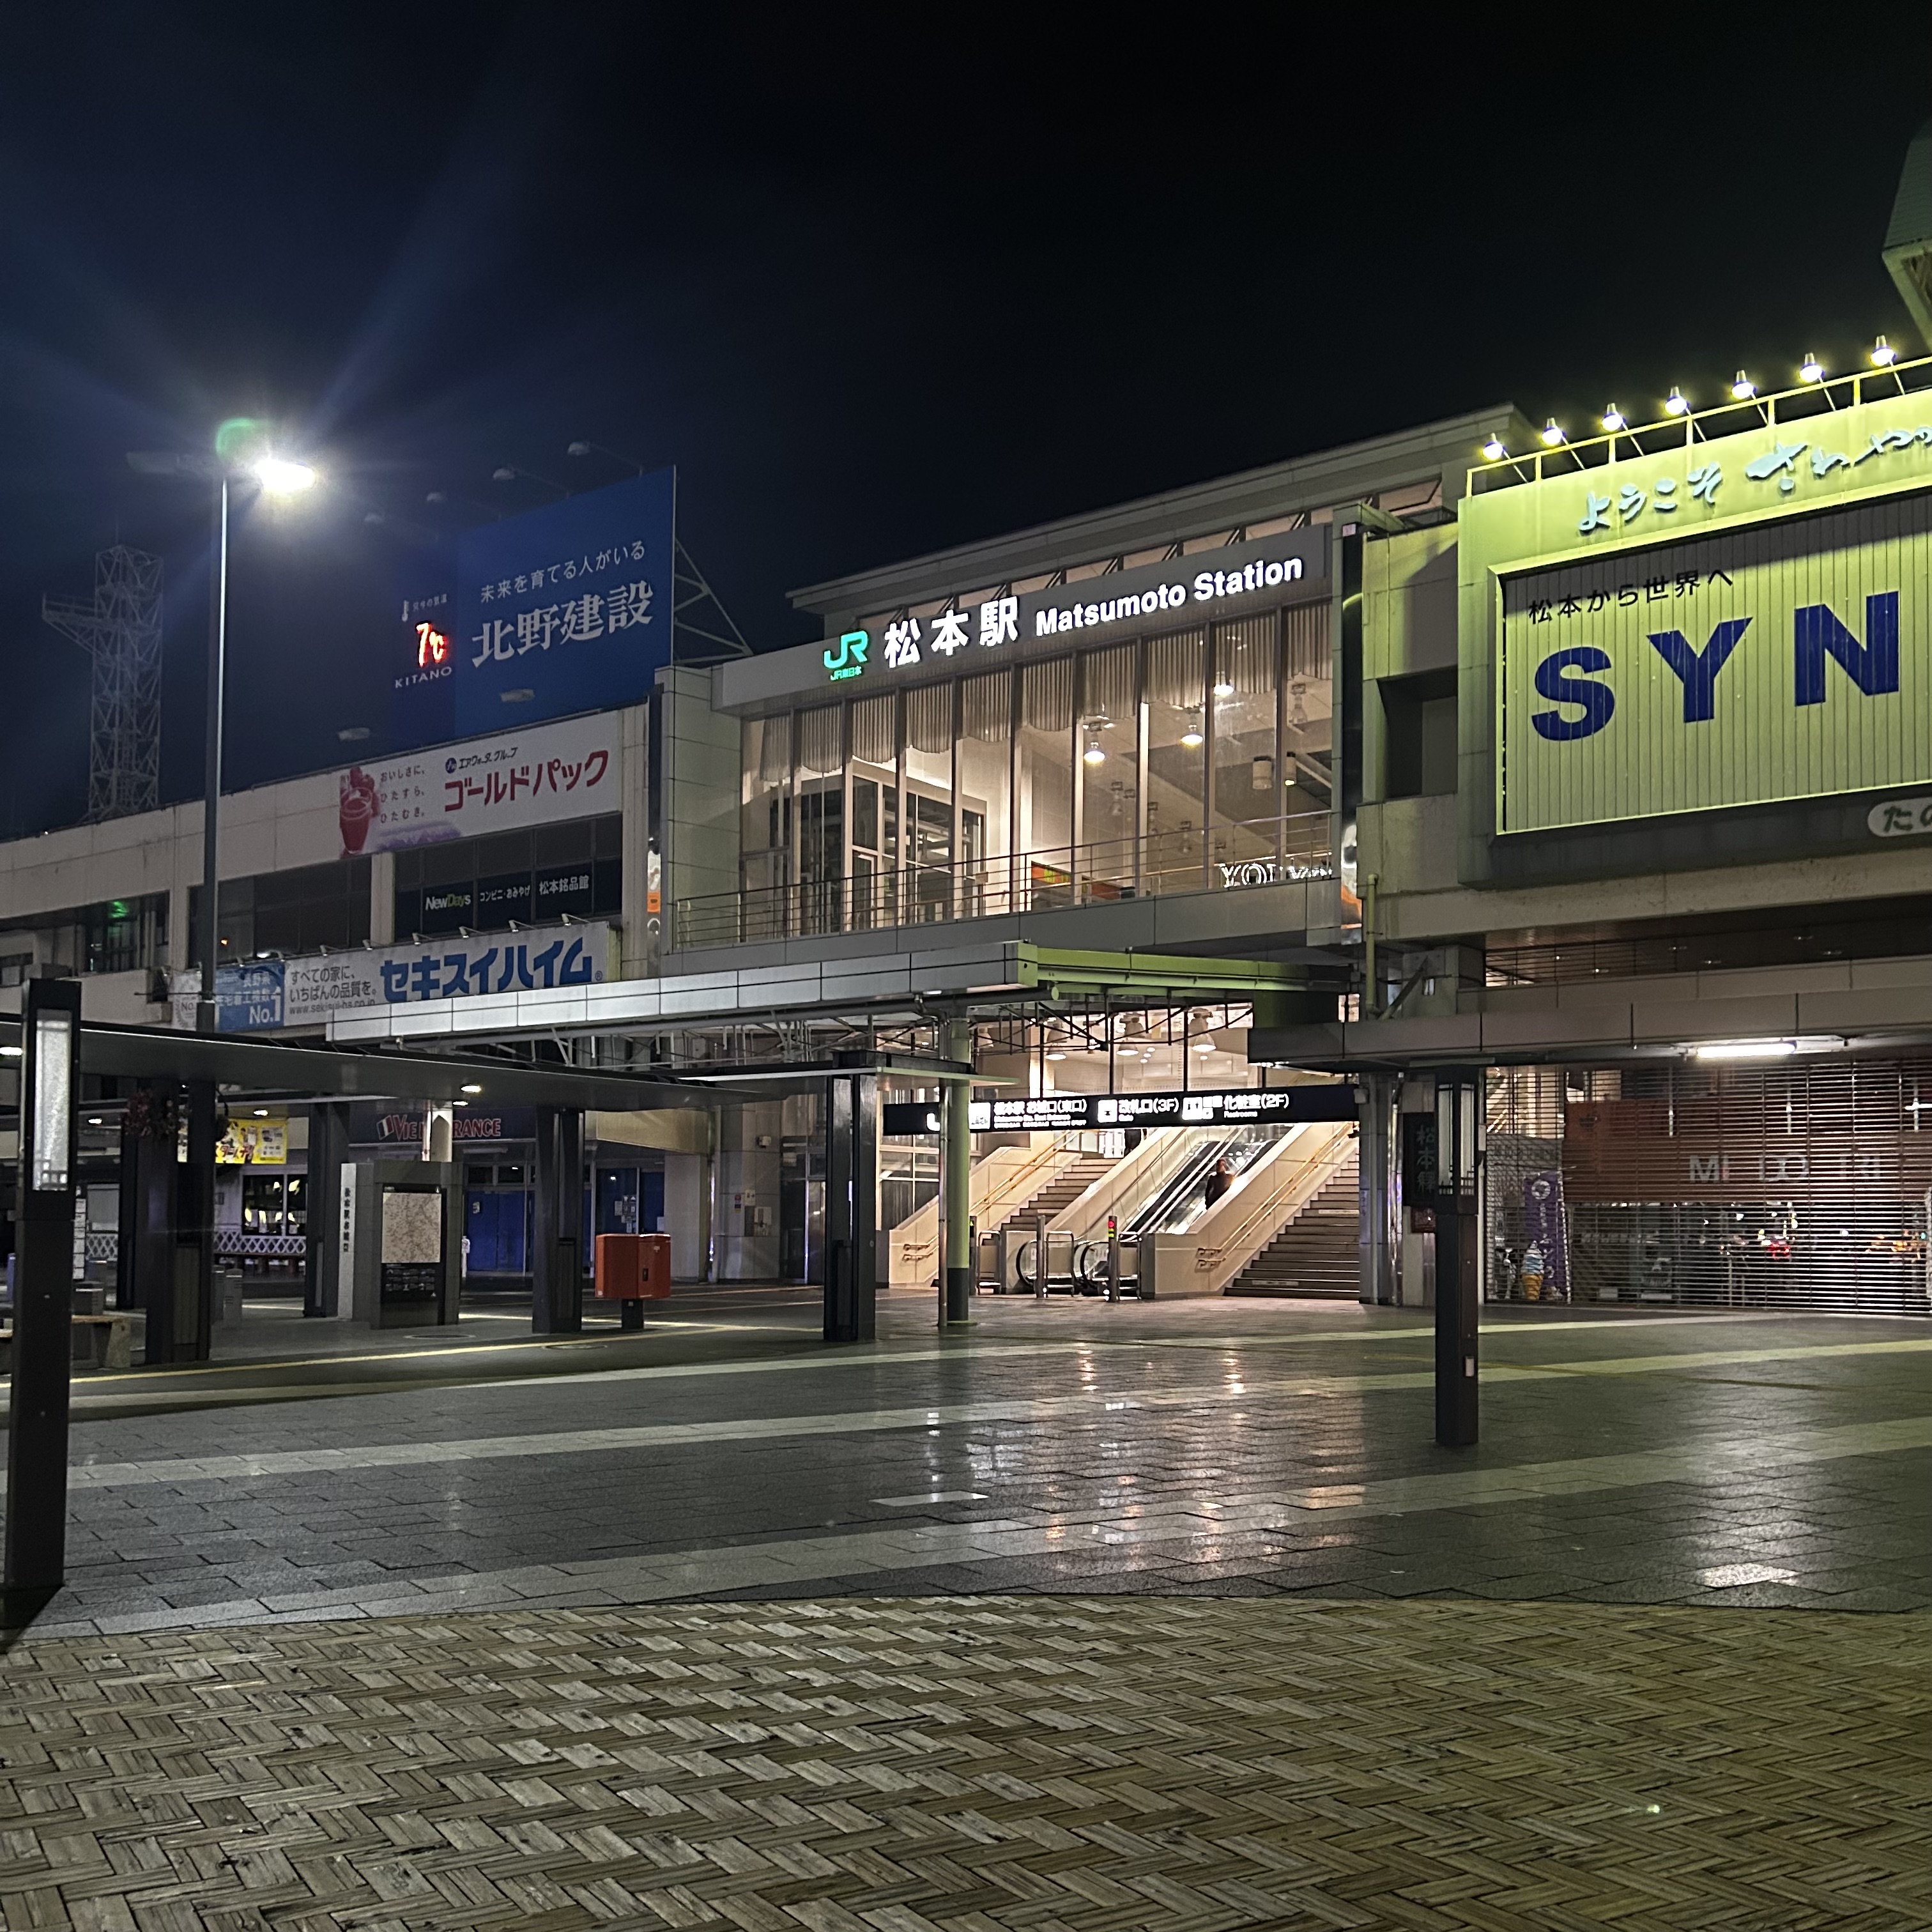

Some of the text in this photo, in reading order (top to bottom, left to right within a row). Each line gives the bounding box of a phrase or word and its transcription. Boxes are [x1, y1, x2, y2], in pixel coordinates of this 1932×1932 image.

[480, 540, 644, 603] 未来を育てる人がいる
[1036, 556, 1303, 637] Matsumoto Station
[1529, 569, 1733, 625] 松本から世界へ
[471, 580, 653, 668] 北野建設
[824, 630, 868, 668] JR
[884, 595, 1020, 668] 松本駅
[395, 666, 452, 688] KITANO
[445, 750, 609, 812] ゴールドパック
[425, 893, 471, 910] NewDays
[379, 937, 593, 1003] セキスイハイム
